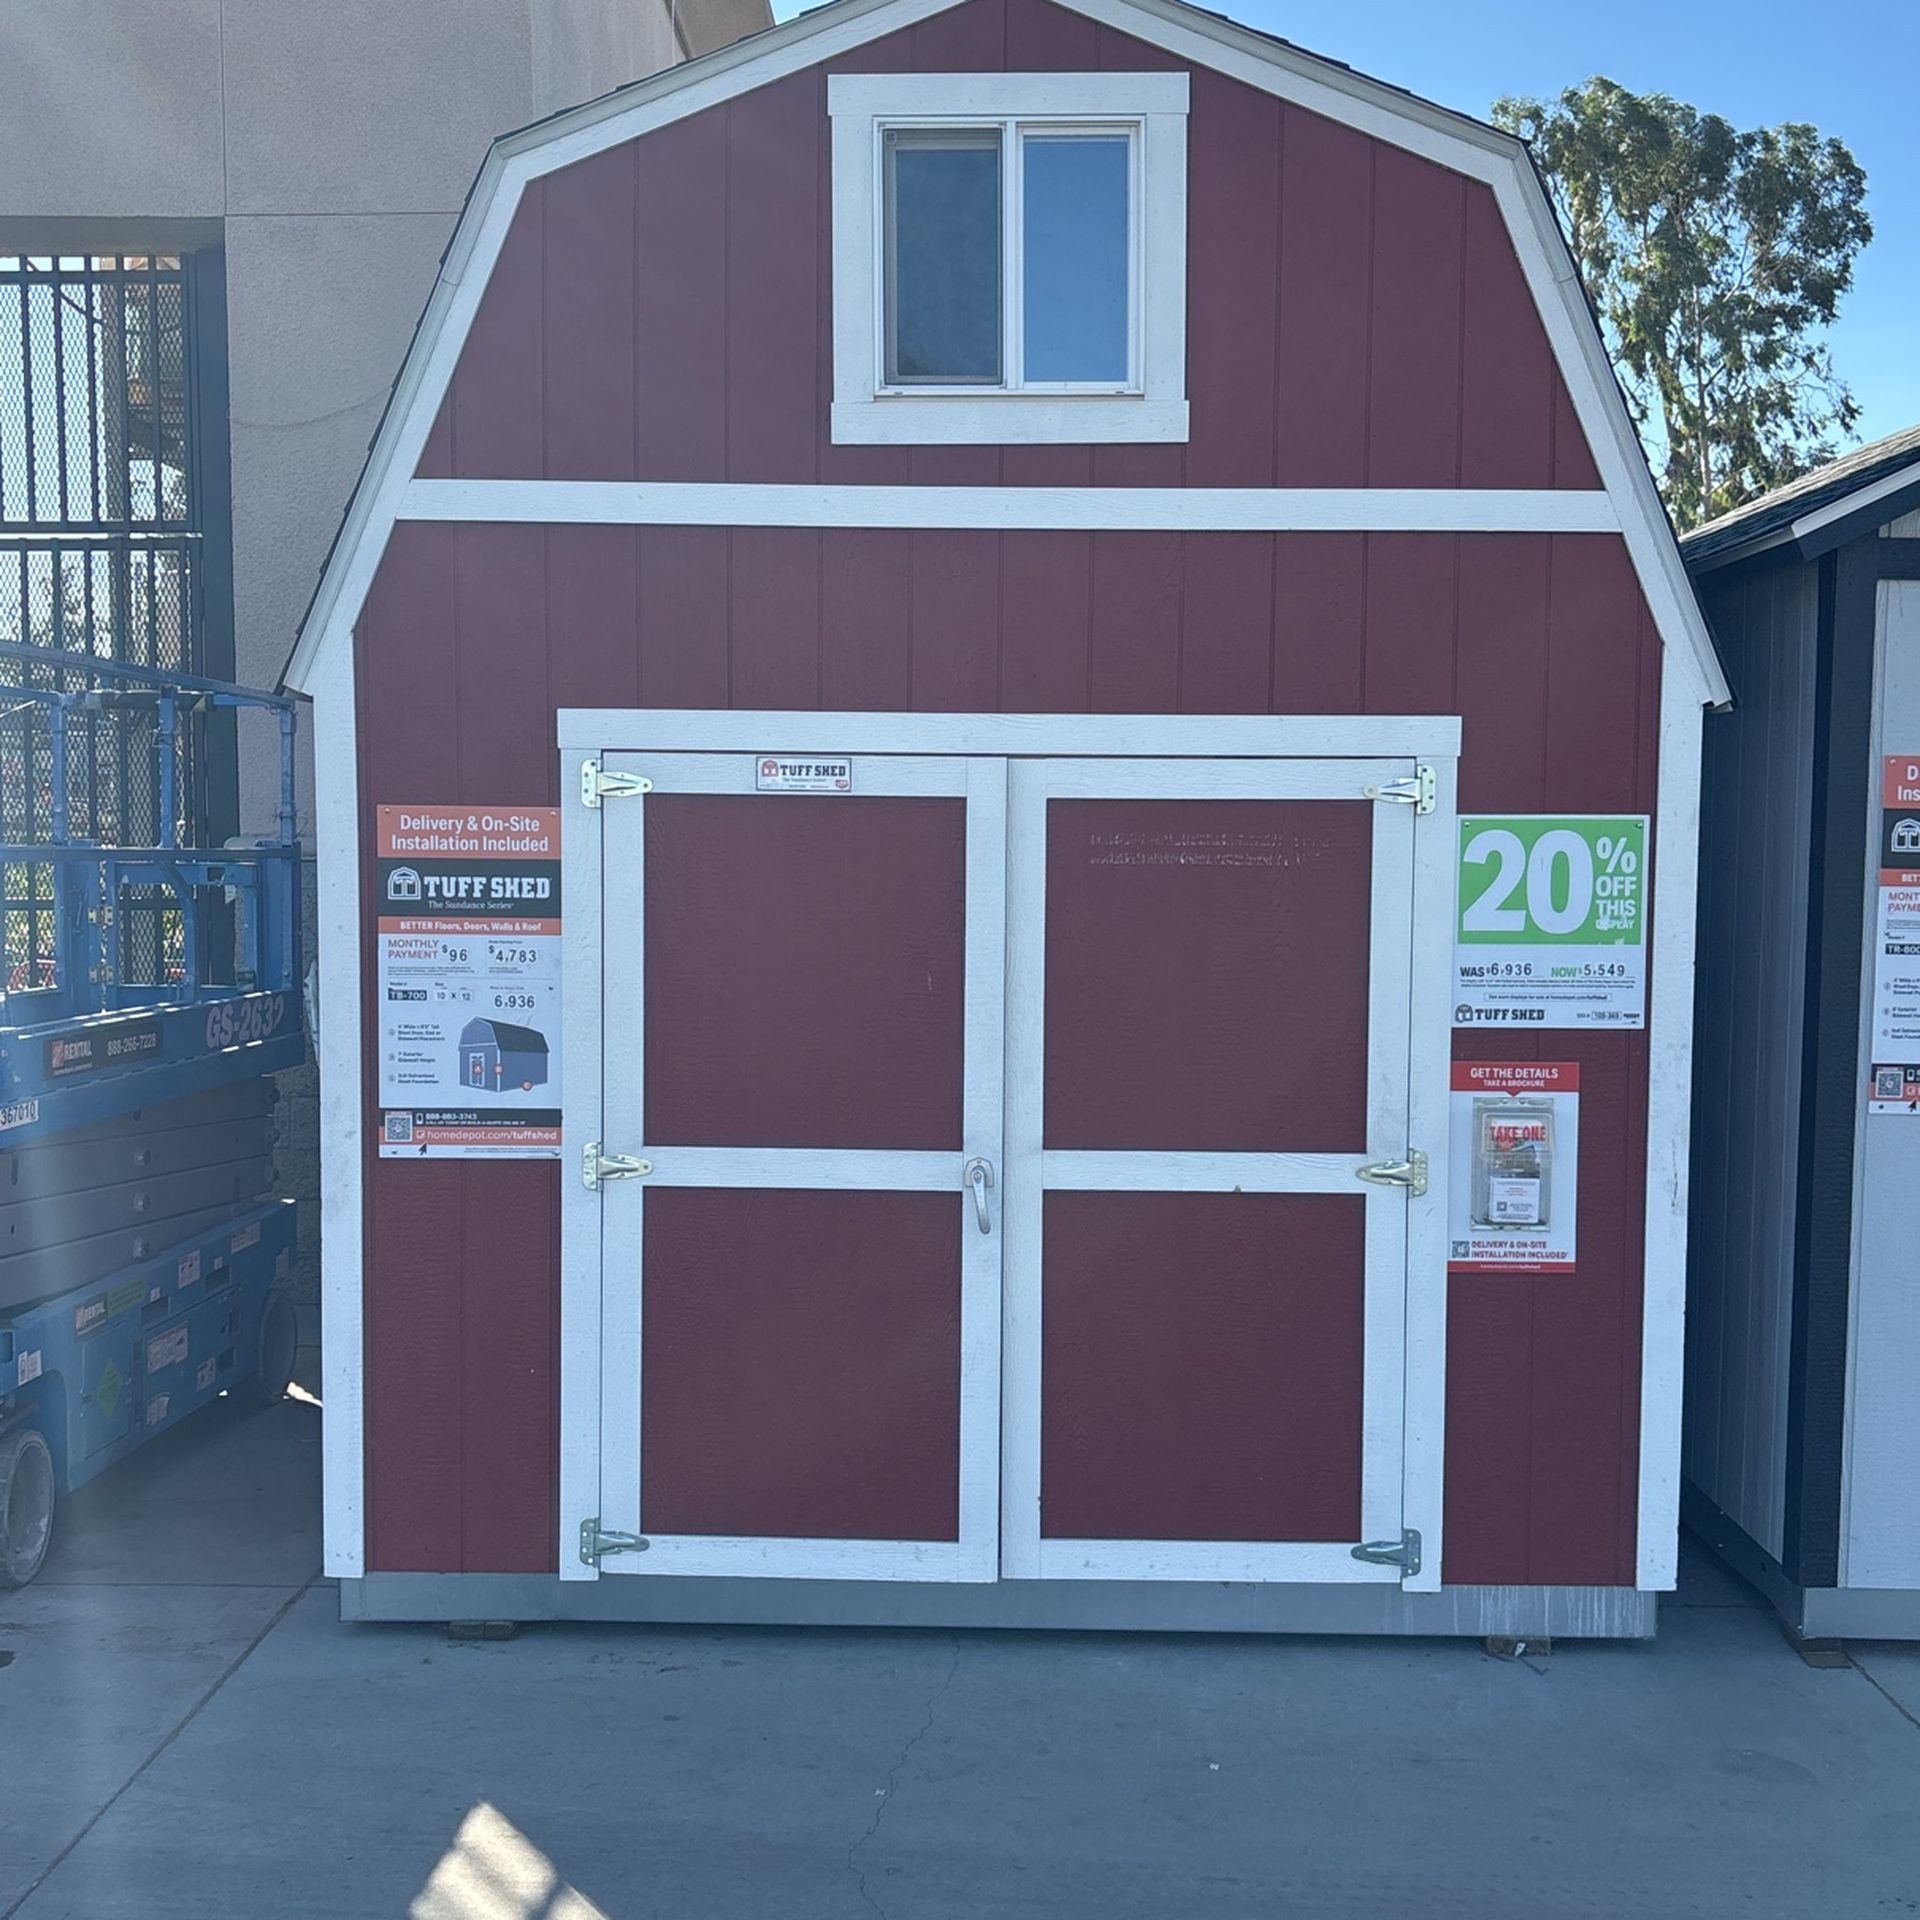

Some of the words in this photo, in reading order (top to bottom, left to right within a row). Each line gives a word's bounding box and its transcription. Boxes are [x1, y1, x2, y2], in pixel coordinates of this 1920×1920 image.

[780, 765, 812, 777] TUFF
[814, 765, 846, 777] SHED
[400, 814, 464, 834] Delivery
[467, 815, 478, 831] &
[481, 815, 540, 832] On-Site
[392, 834, 479, 851] Installation
[483, 836, 549, 852] Included
[423, 876, 487, 898] TUFF
[490, 877, 551, 899] SHED
[1463, 829, 1594, 934] 20
[1596, 836, 1637, 873] %
[1595, 876, 1637, 897] OFF
[428, 900, 443, 909] The
[445, 901, 486, 909] Sundance
[1595, 899, 1637, 917] THIS
[400, 920, 433, 931] BETTER
[434, 921, 462, 932] Floors,
[463, 921, 490, 932] Doors,
[491, 922, 514, 932] Walls
[514, 922, 521, 931] &
[522, 922, 542, 932] Roof
[388, 939, 440, 949] MONTHLY
[388, 949, 439, 959] PAYMENT
[1459, 966, 1485, 978] WAS
[1551, 966, 1578, 978] NOW
[1475, 1009, 1510, 1020] TUFF
[1511, 1009, 1545, 1021] SHED
[1470, 1067, 1491, 1079] GET
[1493, 1068, 1513, 1079] THE
[1515, 1068, 1559, 1079] DETAILS
[1483, 1079, 1500, 1087] TAKE
[1508, 1079, 1545, 1087] BROCHURE
[427, 1131, 557, 1142] homedepot.com/tuffshed
[1490, 1126, 1518, 1141] TAKE
[1522, 1126, 1546, 1141] ONE
[1471, 1240, 1508, 1249] DELIVERY
[1509, 1241, 1515, 1249] &
[1516, 1241, 1548, 1249] ON-SITE
[1471, 1250, 1527, 1259] INSTALLATION
